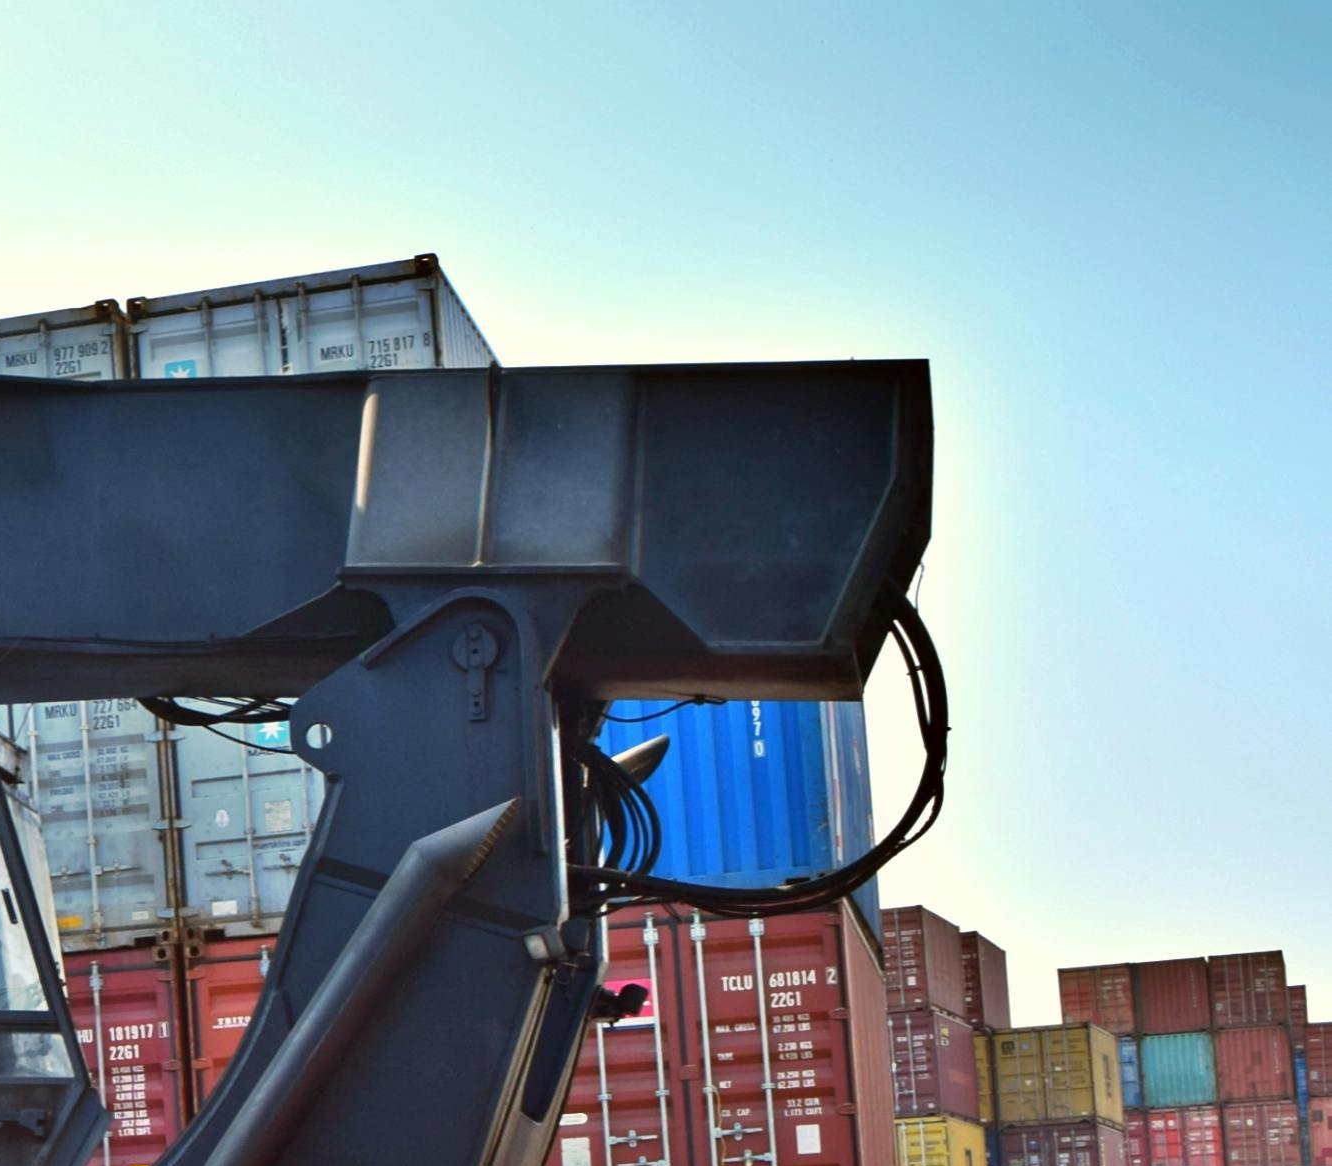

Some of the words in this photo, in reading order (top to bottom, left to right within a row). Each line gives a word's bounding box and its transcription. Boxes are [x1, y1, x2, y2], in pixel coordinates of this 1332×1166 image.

[369, 339, 390, 354] 715
[393, 335, 414, 352] 817
[54, 346, 74, 361] 977
[45, 703, 77, 719] MRKU
[721, 975, 753, 991] TCLU
[769, 970, 816, 988] 681814
[827, 968, 836, 984] 2
[770, 992, 801, 1008] 22G1
[217, 1016, 251, 1025] TRITO
[78, 1029, 93, 1043] HU
[109, 1024, 153, 1041] 181917
